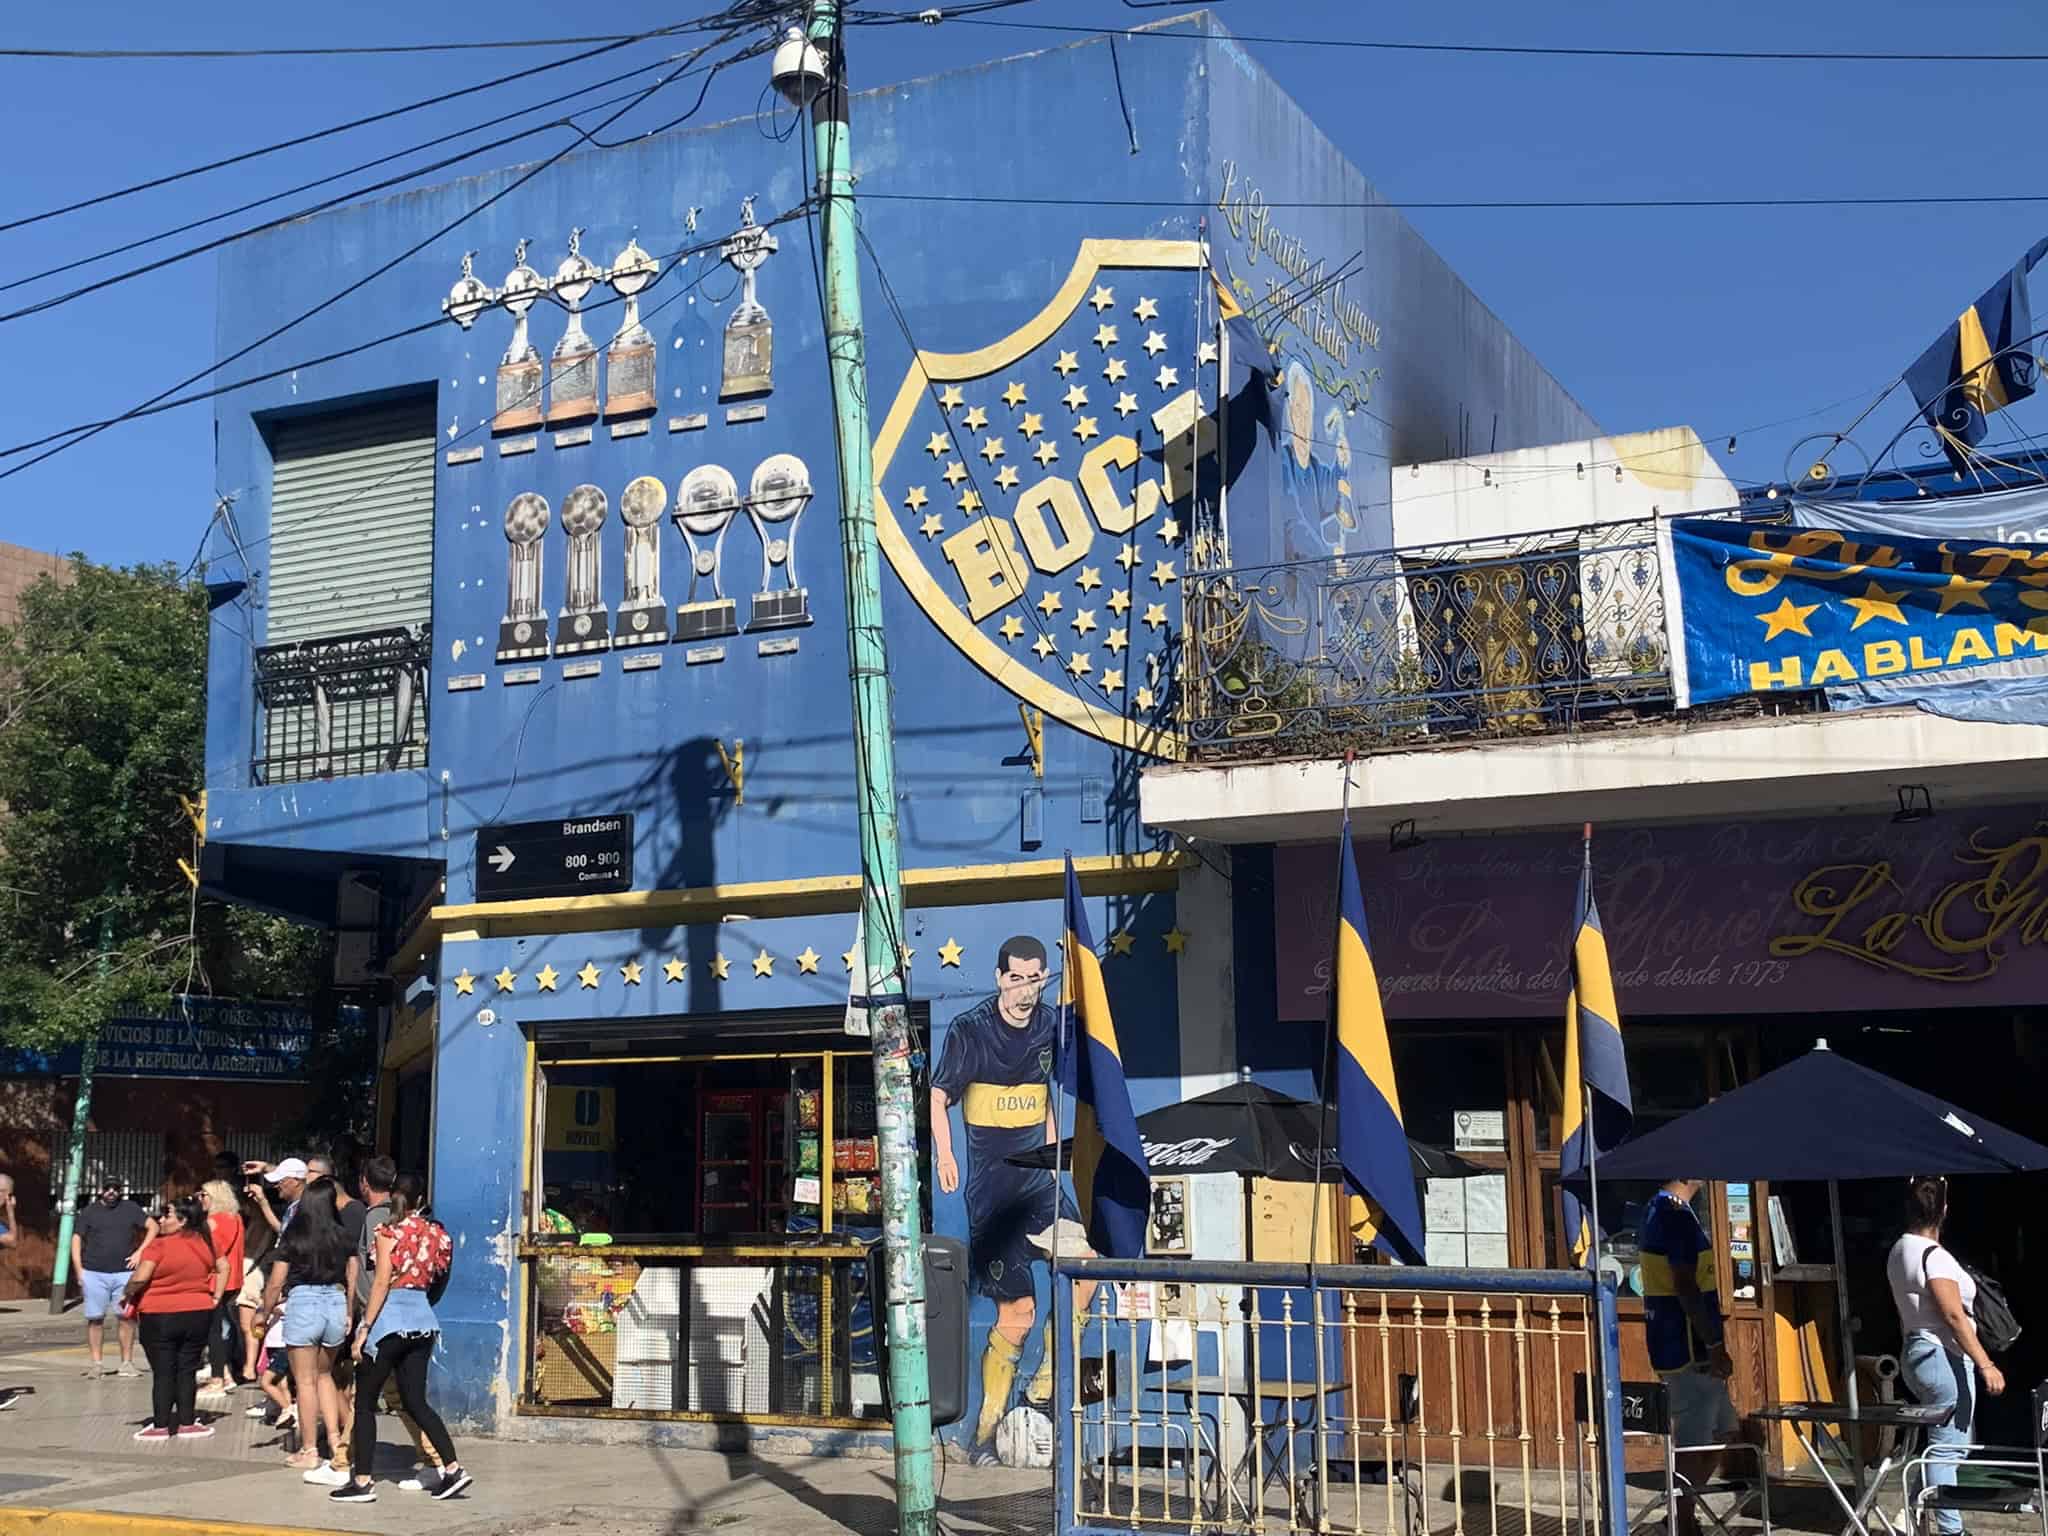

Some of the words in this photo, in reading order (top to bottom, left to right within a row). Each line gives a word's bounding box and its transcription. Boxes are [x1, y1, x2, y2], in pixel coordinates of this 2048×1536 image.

[942, 389, 1220, 623] BOCA
[563, 820, 621, 835] Brandsen
[566, 853, 588, 868] 800
[597, 851, 620, 865] 900
[613, 868, 619, 878] 4
[1377, 962, 1441, 1008] ejores
[1653, 953, 1722, 988] desde
[1727, 959, 1793, 989] 1973
[112, 1050, 131, 1068] LA
[212, 1054, 284, 1075] ARGENTINA
[996, 1095, 1038, 1112] BBVA
